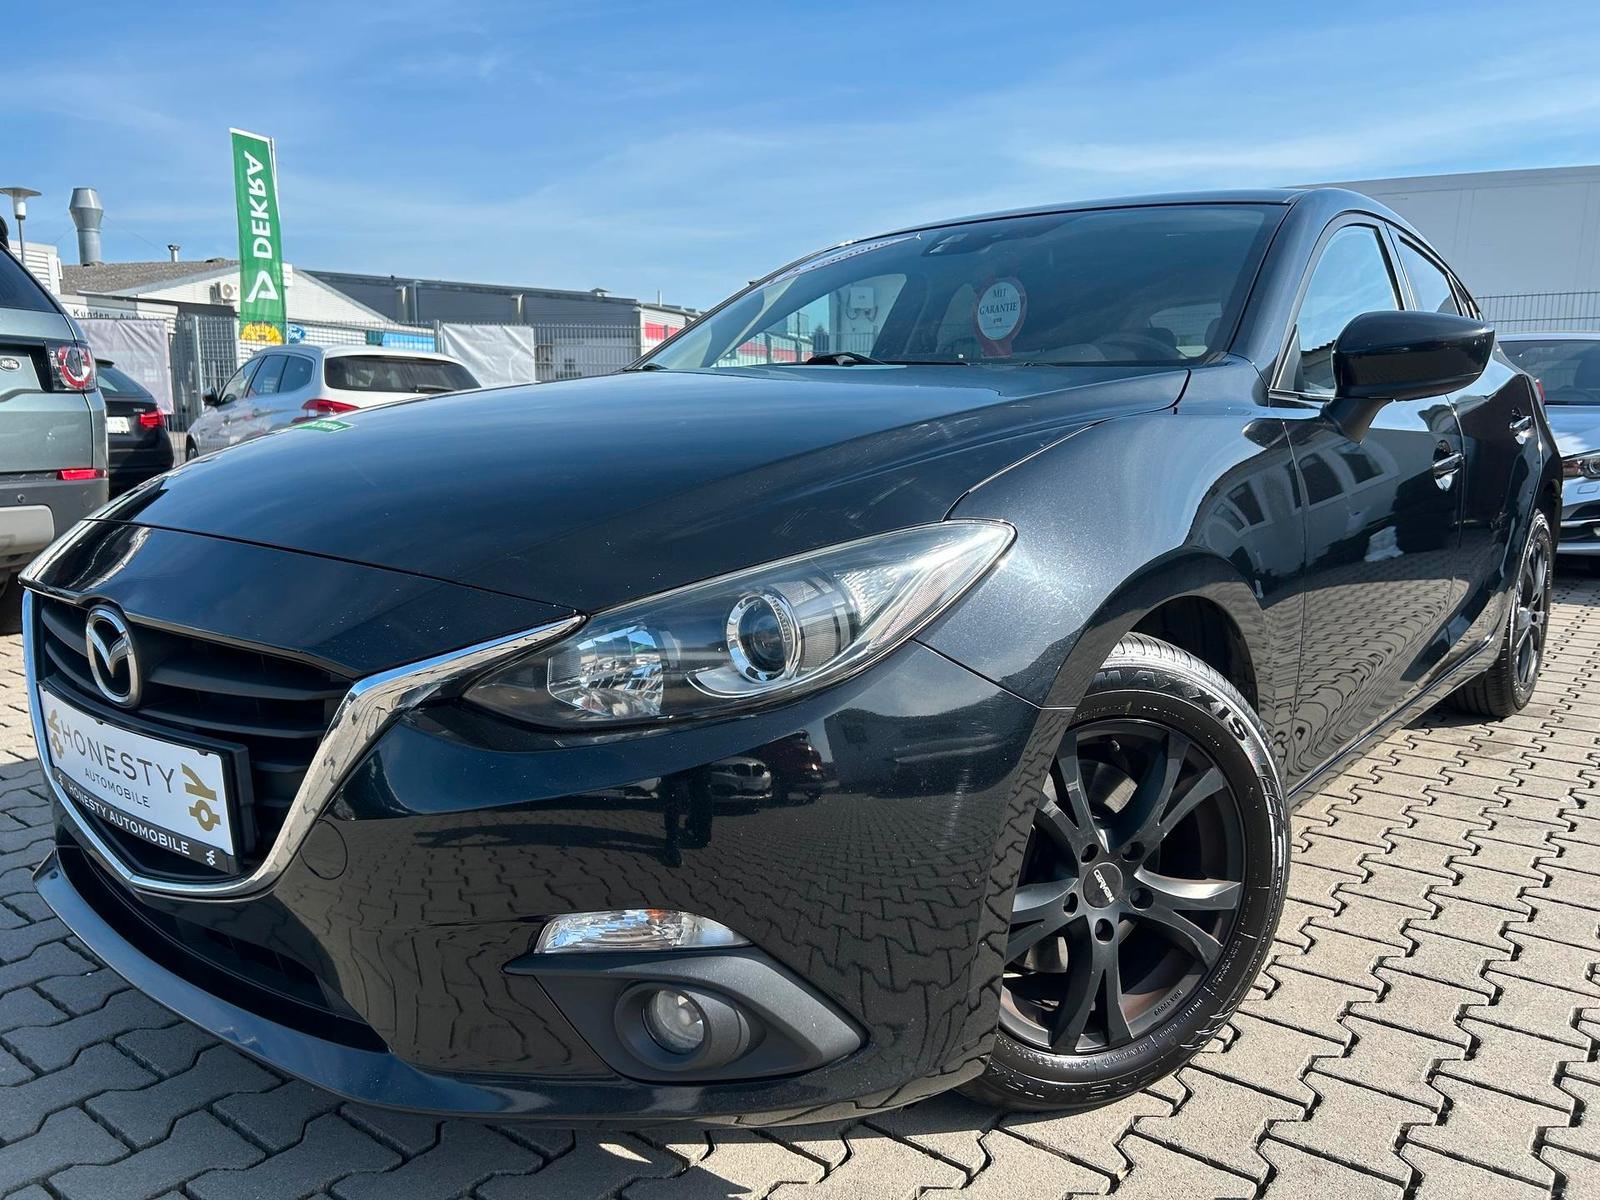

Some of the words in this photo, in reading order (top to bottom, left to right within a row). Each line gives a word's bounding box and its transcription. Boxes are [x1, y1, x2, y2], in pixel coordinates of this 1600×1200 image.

[73, 309, 110, 319] Kunden
[979, 302, 1018, 315] GARANTIE
[1091, 669, 1249, 741] MAXXIS
[60, 719, 175, 793] HONESTY
[85, 767, 151, 808] AUTOMOBILE
[68, 781, 106, 817] HONESTY
[109, 811, 190, 855] AUTOMOBILE
